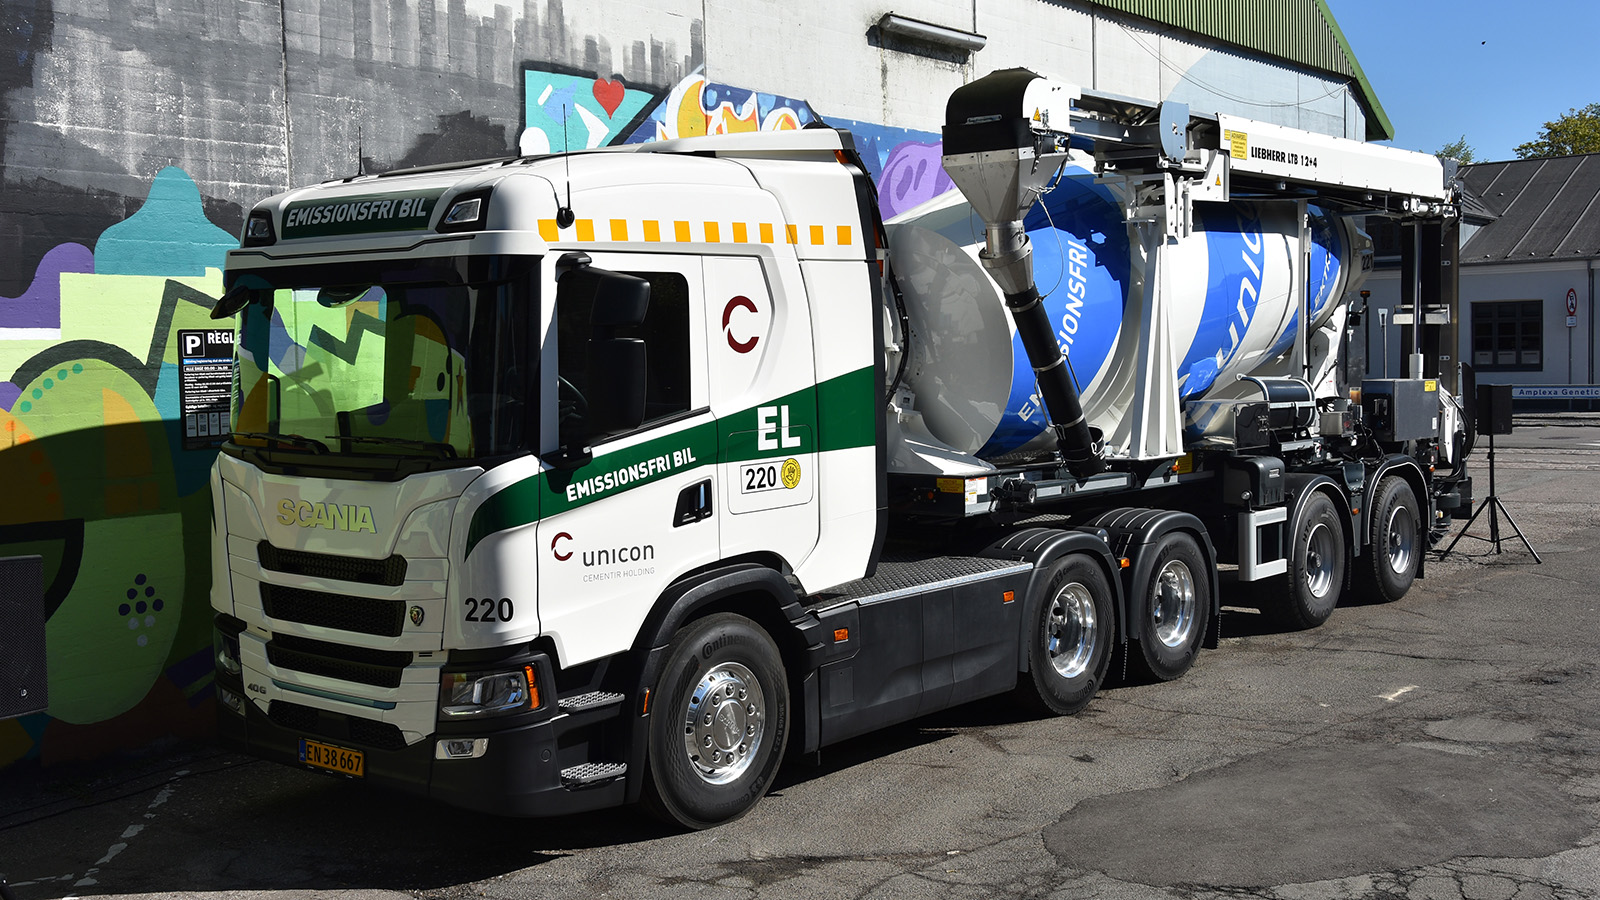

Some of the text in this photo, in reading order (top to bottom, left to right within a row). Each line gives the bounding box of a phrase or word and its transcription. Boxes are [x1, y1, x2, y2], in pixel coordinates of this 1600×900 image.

[1250, 146, 1286, 163] LIEBHERR
[1287, 152, 1299, 165] LTB
[1300, 154, 1318, 168] 12+4
[286, 197, 427, 228] EMISSIONSFRI BIL
[185, 335, 201, 355] P
[757, 404, 801, 451] EL
[566, 447, 697, 502] EMISSIONSFRI BIL
[745, 465, 777, 491] 220
[276, 498, 378, 534] SCANIA
[582, 544, 655, 567] unicon
[583, 567, 655, 583] CEMENTIR HOLDING
[464, 597, 514, 623] 220
[307, 745, 362, 771] EN 38 667
